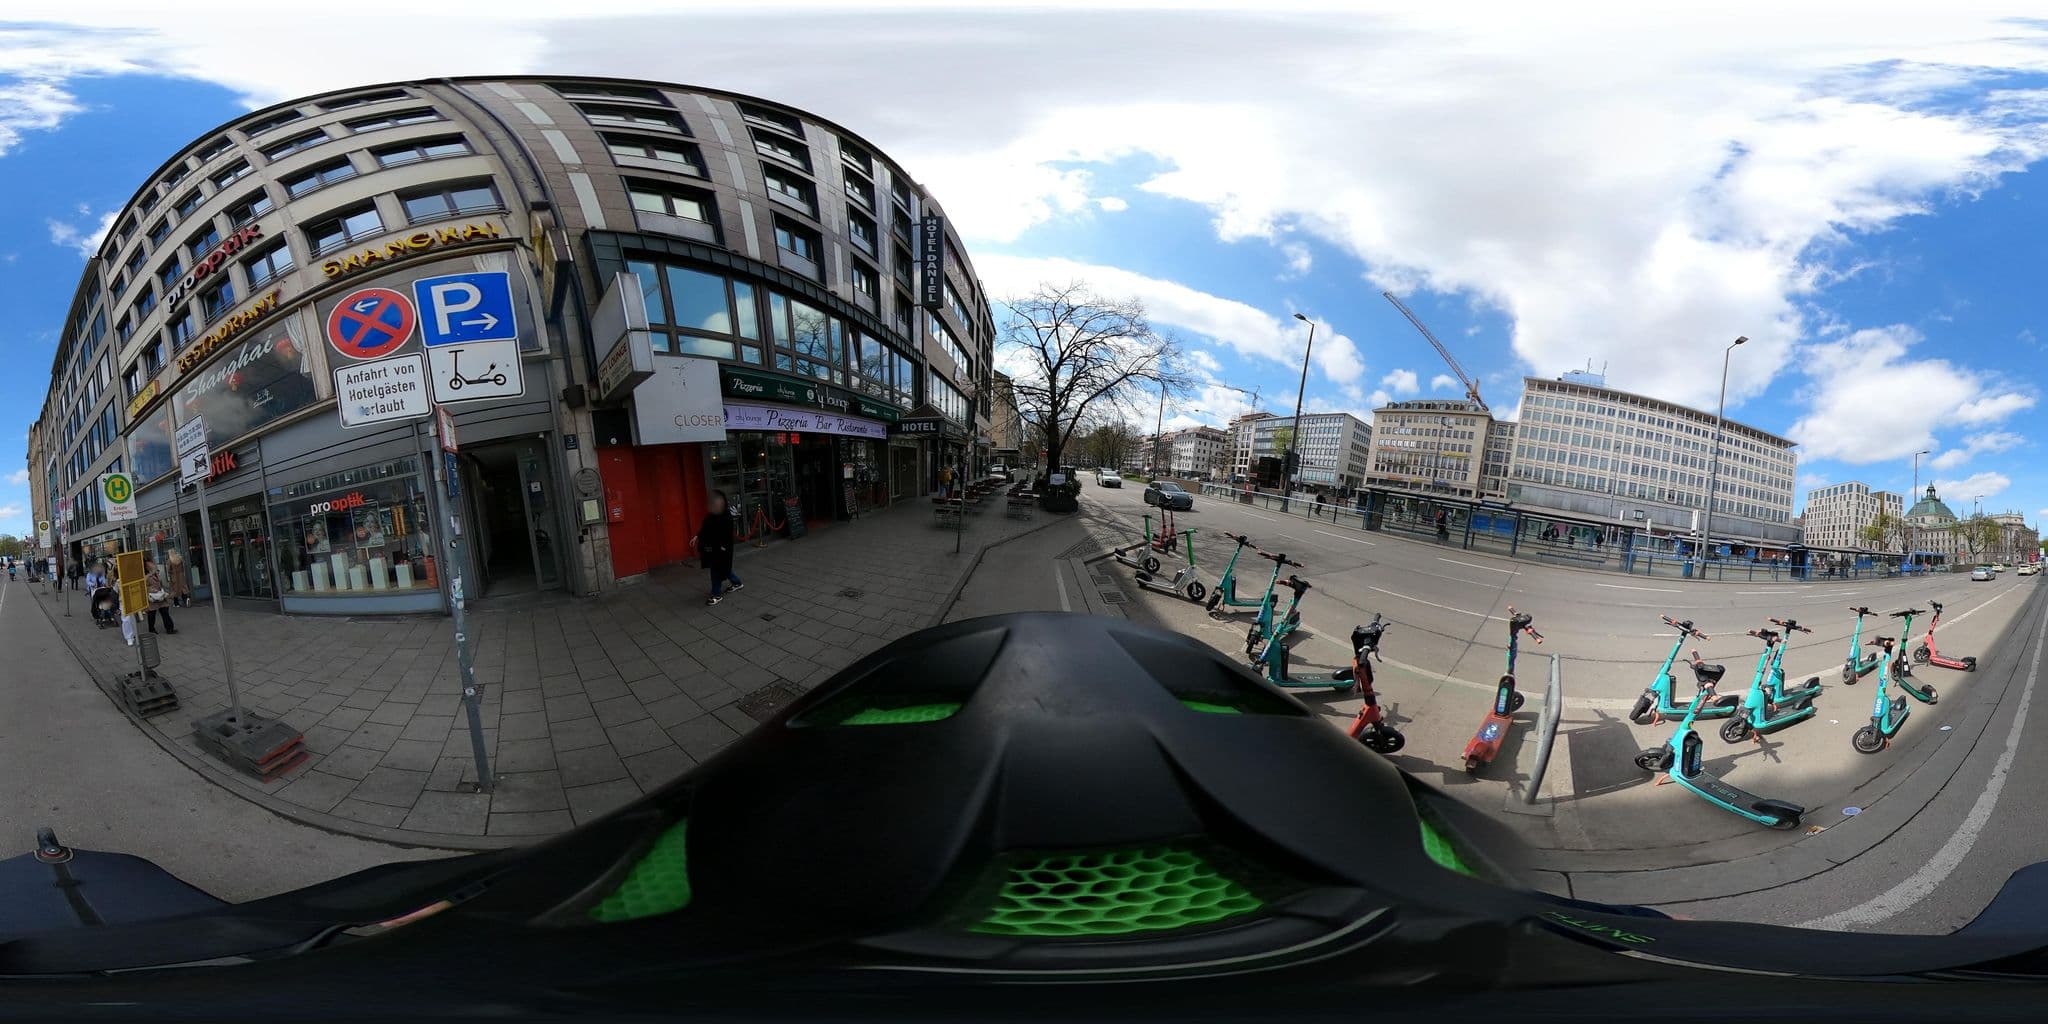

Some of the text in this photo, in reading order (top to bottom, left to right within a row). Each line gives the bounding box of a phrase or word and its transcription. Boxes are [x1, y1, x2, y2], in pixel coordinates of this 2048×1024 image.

[926, 219, 937, 302] HOTEL DANIEL
[430, 282, 482, 336] P
[177, 289, 281, 374] RESTAURANT
[185, 333, 274, 404] Shanghai
[346, 364, 415, 385] Anfahrt von
[348, 381, 416, 402] Hotelgästen
[733, 378, 764, 393] Pizzeria
[674, 414, 721, 428] CLOSER
[766, 409, 808, 430] Pizzeria
[815, 415, 832, 430] Bar
[837, 418, 868, 434] Ristorante
[902, 422, 936, 432] HOTEL
[310, 491, 365, 517] prooptik
